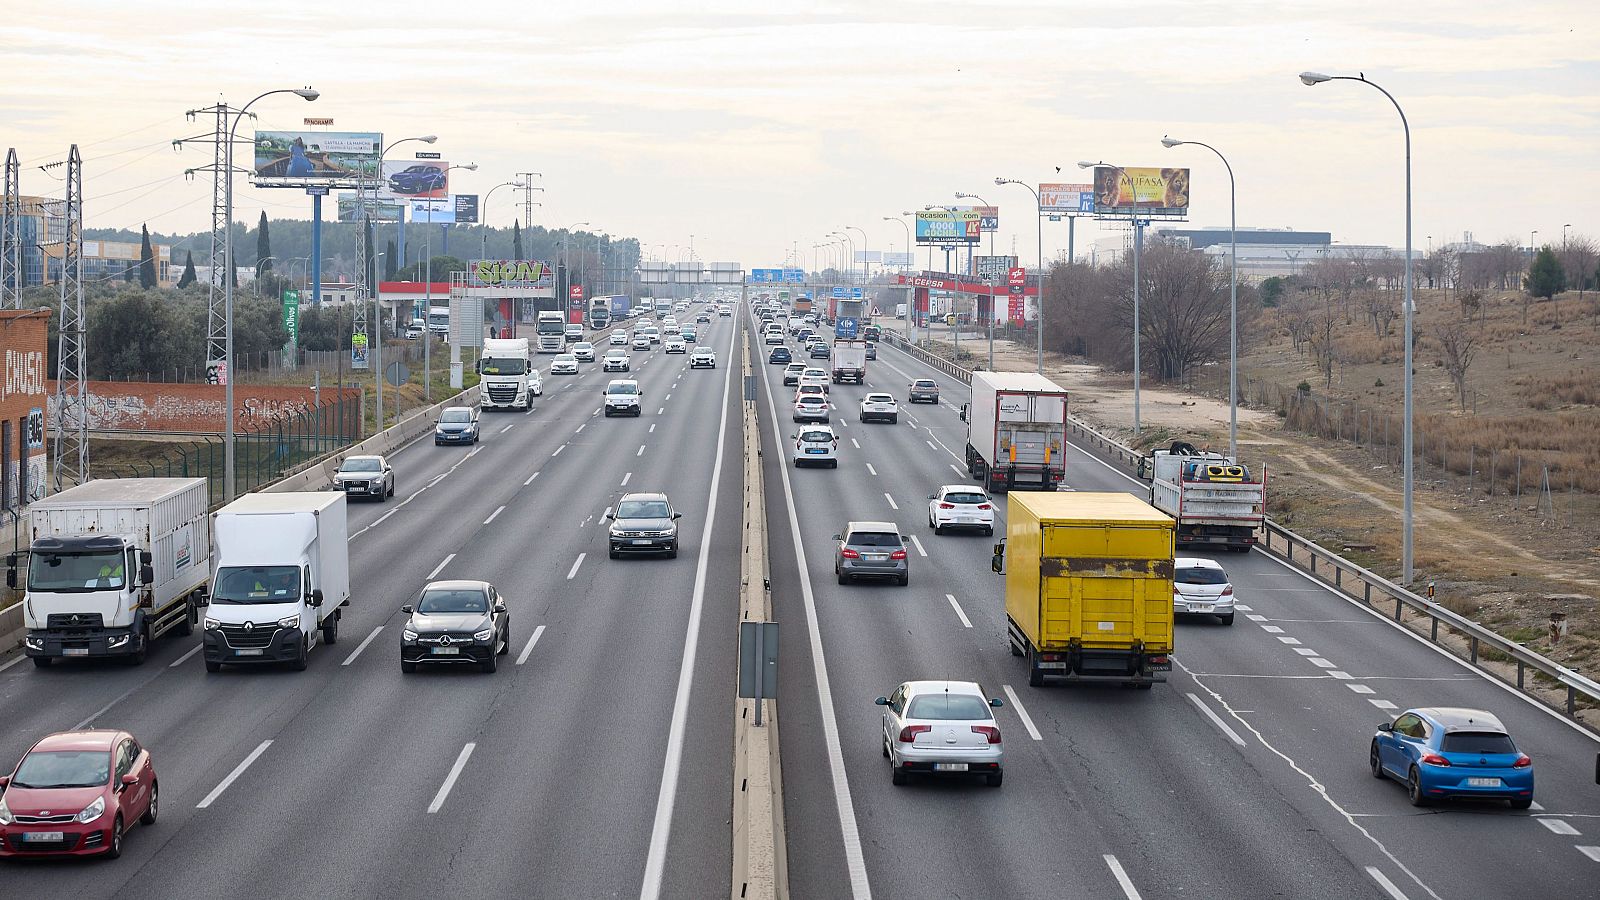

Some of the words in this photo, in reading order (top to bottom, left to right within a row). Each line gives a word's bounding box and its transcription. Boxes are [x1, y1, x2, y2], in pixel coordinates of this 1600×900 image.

[1121, 177, 1163, 187] MUFASA
[930, 222, 955, 230] 4000
[915, 278, 943, 287] CEPSA
